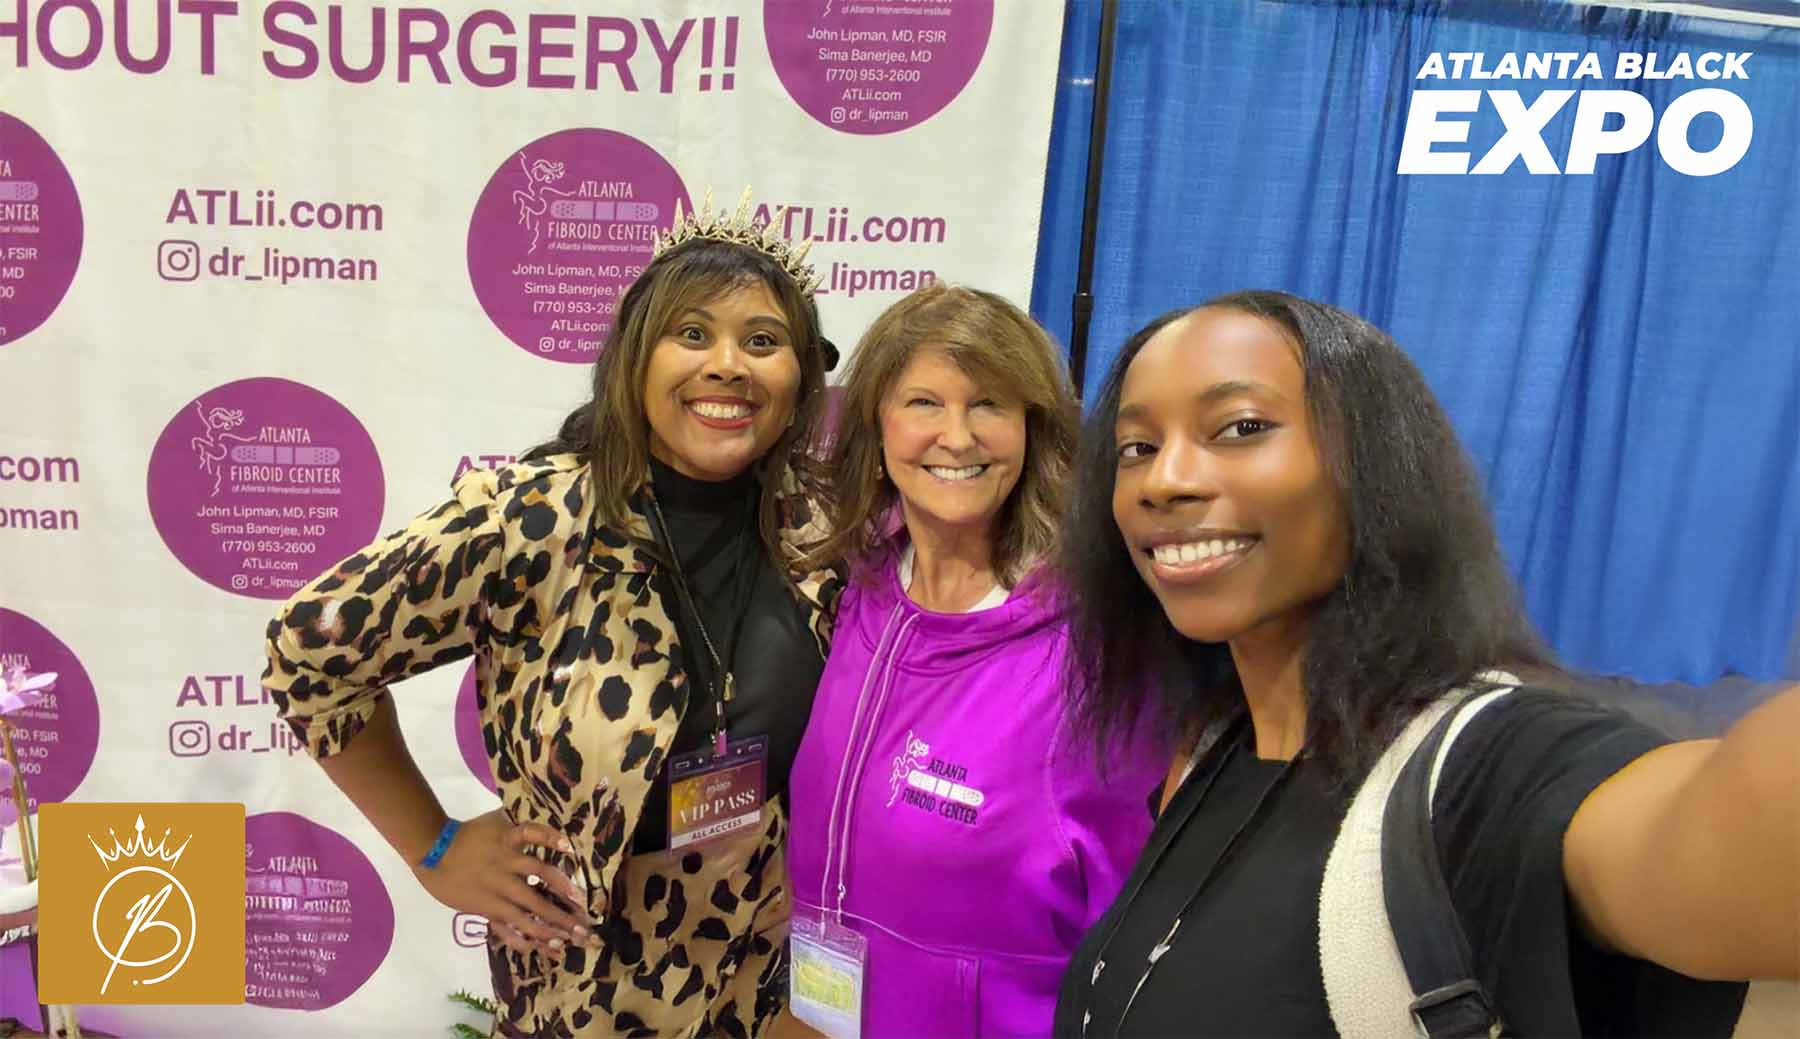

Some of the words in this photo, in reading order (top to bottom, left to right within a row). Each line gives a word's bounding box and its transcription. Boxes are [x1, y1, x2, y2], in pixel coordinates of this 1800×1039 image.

[807, 27, 838, 41] John
[840, 29, 888, 43] Lipman,
[891, 30, 915, 43] MD,
[918, 30, 946, 43] FSIR
[262, 0, 740, 94] SURGERY!!
[818, 48, 848, 61] Sima
[851, 50, 908, 64] Banerjee,
[910, 51, 932, 63] MD
[826, 69, 857, 82] (770)
[859, 70, 920, 83] 953-2600
[841, 88, 902, 101] ATLii.com
[849, 108, 909, 122] dr_lipman
[578, 180, 633, 198] ATLANTA
[166, 189, 382, 230] ATLii.com
[752, 203, 946, 242] ATLii.com
[547, 221, 601, 240] FIBROID
[608, 223, 658, 241] CENTER
[8, 247, 38, 261] FSIR
[3, 266, 24, 279] MD
[208, 247, 377, 285] dr_lipman
[512, 264, 545, 275] John
[548, 264, 595, 278] Lipman,
[598, 266, 622, 278] MD,
[625, 266, 641, 278] FS
[524, 282, 556, 294] Sima
[559, 283, 616, 298] Banerjee,
[534, 302, 565, 314] (770)
[568, 302, 613, 314] 953-26
[551, 320, 608, 332] ATLii.com
[559, 338, 601, 352] dr_lipm
[259, 427, 311, 444] ATLANTA
[231, 466, 283, 482] FIBROID
[289, 467, 341, 484] CENTER
[197, 506, 230, 517] John
[234, 506, 280, 519] Lipman,
[283, 507, 306, 518] MD,
[309, 507, 339, 518] FSIR
[211, 523, 243, 534] Sima
[247, 523, 300, 537] Banerjee,
[304, 525, 326, 536] MD
[222, 541, 254, 552] (770)
[257, 541, 316, 553] 953-2600
[242, 559, 298, 571] ATLii.com
[33, 729, 58, 742] FSIR
[218, 723, 300, 756] dr_lip
[30, 746, 48, 758] MD
[680, 802, 710, 824] VIP
[714, 788, 755, 815] PASS
[939, 800, 978, 826] CENTER
